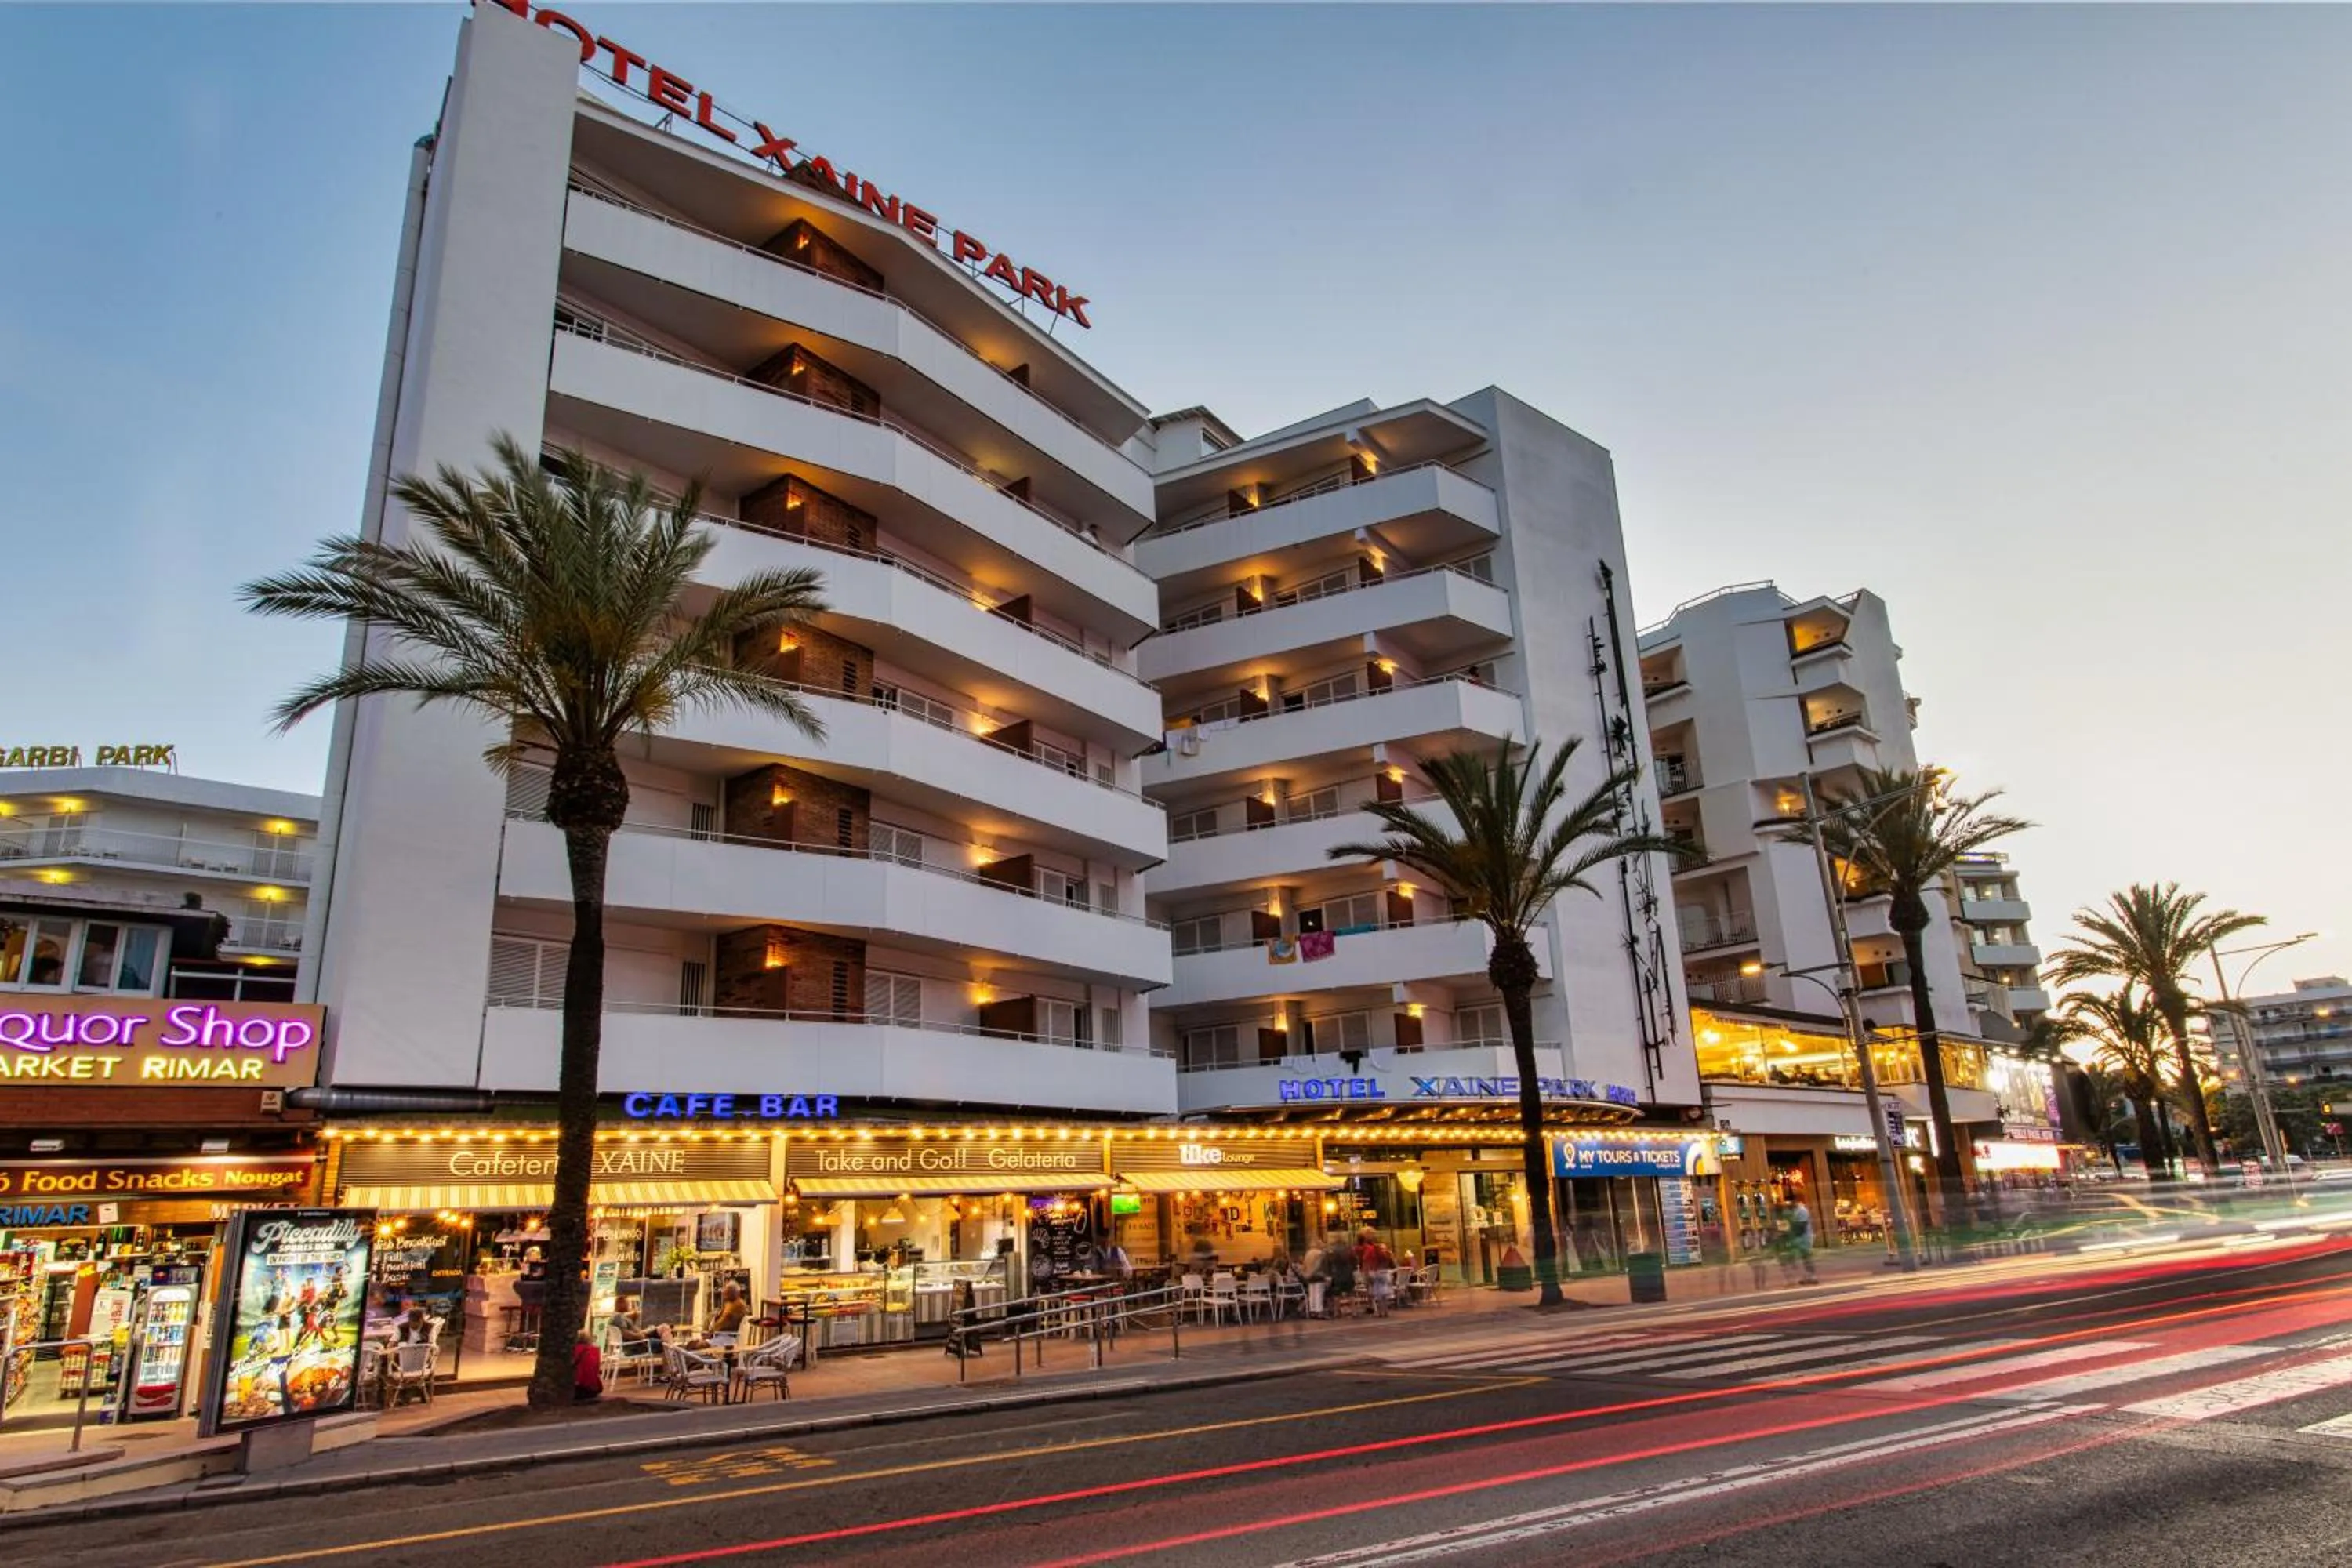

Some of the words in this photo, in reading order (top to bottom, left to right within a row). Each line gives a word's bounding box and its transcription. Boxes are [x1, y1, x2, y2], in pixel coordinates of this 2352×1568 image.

[473, 0, 737, 143] OTEL
[953, 229, 1091, 329] PARK
[95, 745, 175, 766] PARK
[161, 1004, 312, 1064] Shop
[141, 1056, 264, 1080] RIMAR
[1279, 1078, 1385, 1100] HOTEL
[1409, 1076, 1519, 1097] XAINE
[449, 1150, 560, 1176] Cafeteri
[598, 1149, 685, 1174] XAINE
[815, 1149, 864, 1171] Take
[870, 1149, 912, 1171] and
[988, 1147, 1077, 1169] Gelateria
[1578, 1150, 1595, 1163] MY
[1596, 1149, 1633, 1164] TOURS
[1639, 1149, 1681, 1164] TICKETS
[21, 1170, 98, 1192] Food
[105, 1167, 215, 1190] Snacks
[224, 1170, 304, 1186] Nougat
[251, 1218, 363, 1254] Piccadilly
